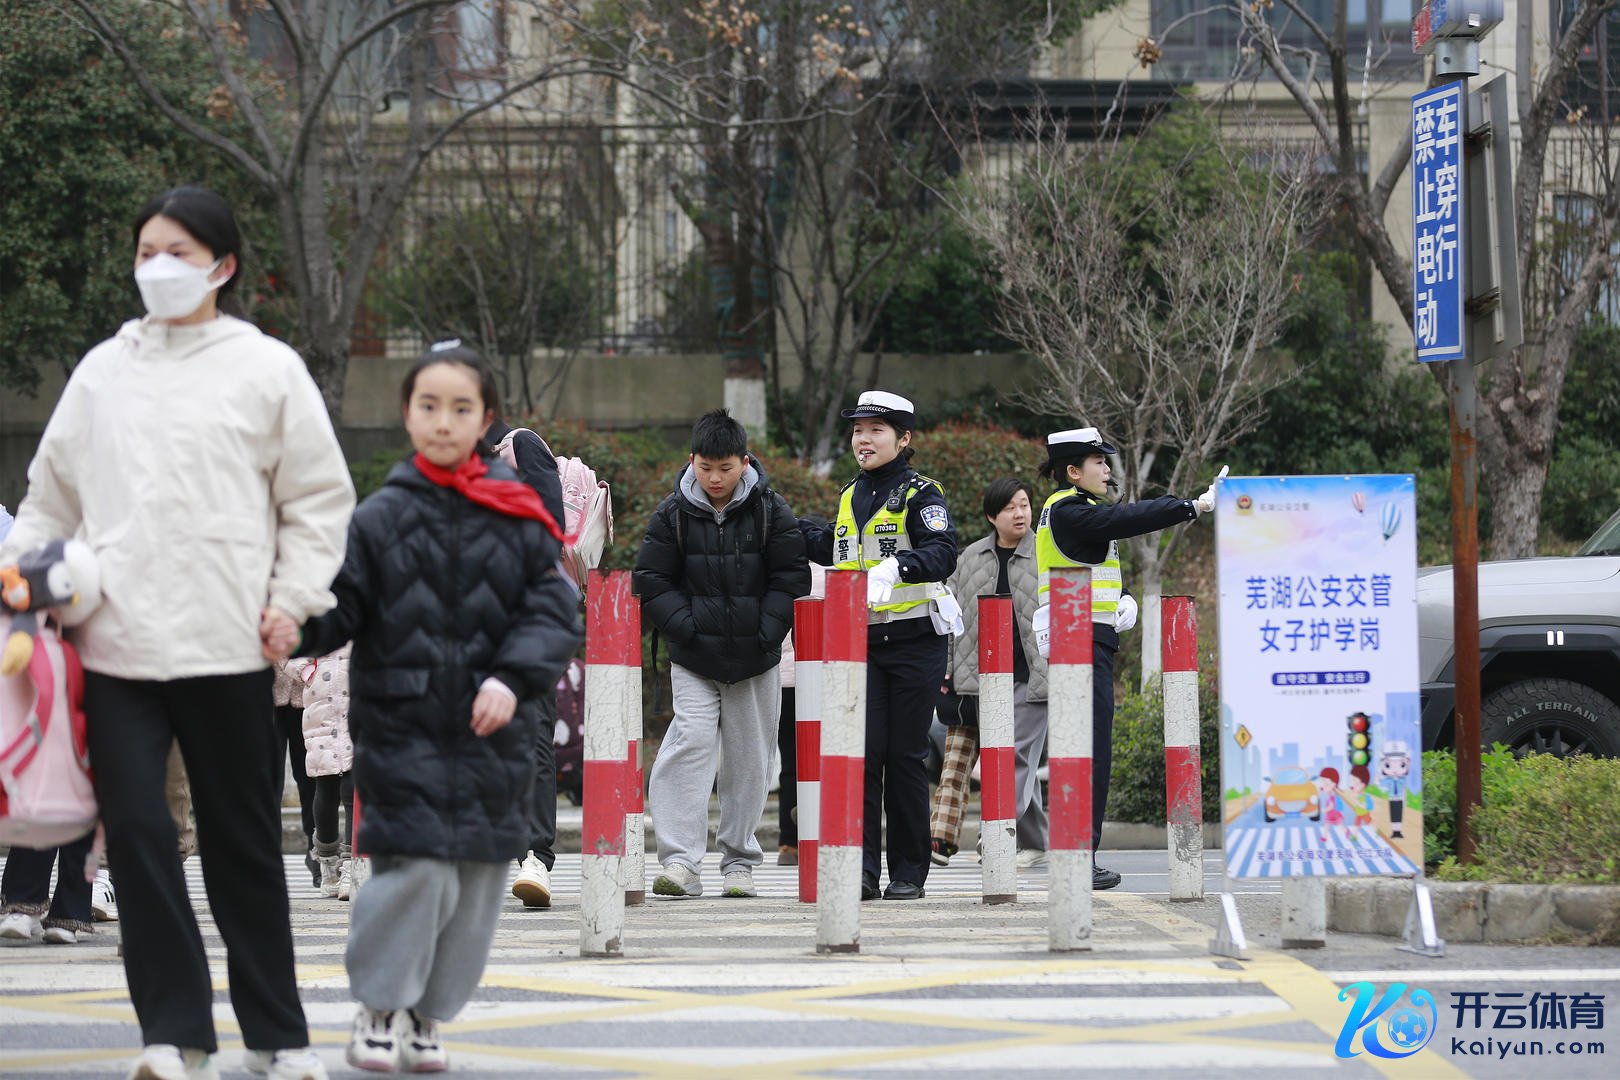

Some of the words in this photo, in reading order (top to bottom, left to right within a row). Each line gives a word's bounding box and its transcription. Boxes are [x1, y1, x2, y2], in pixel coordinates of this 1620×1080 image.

[1436, 98, 1458, 283] 车穿行
[1415, 105, 1437, 346] 禁止电动
[1245, 573, 1392, 609] 芜湖公安交管
[1259, 617, 1379, 653] 女子护学岗
[1505, 707, 1530, 726] ALL
[1536, 701, 1599, 722] TERRAIN
